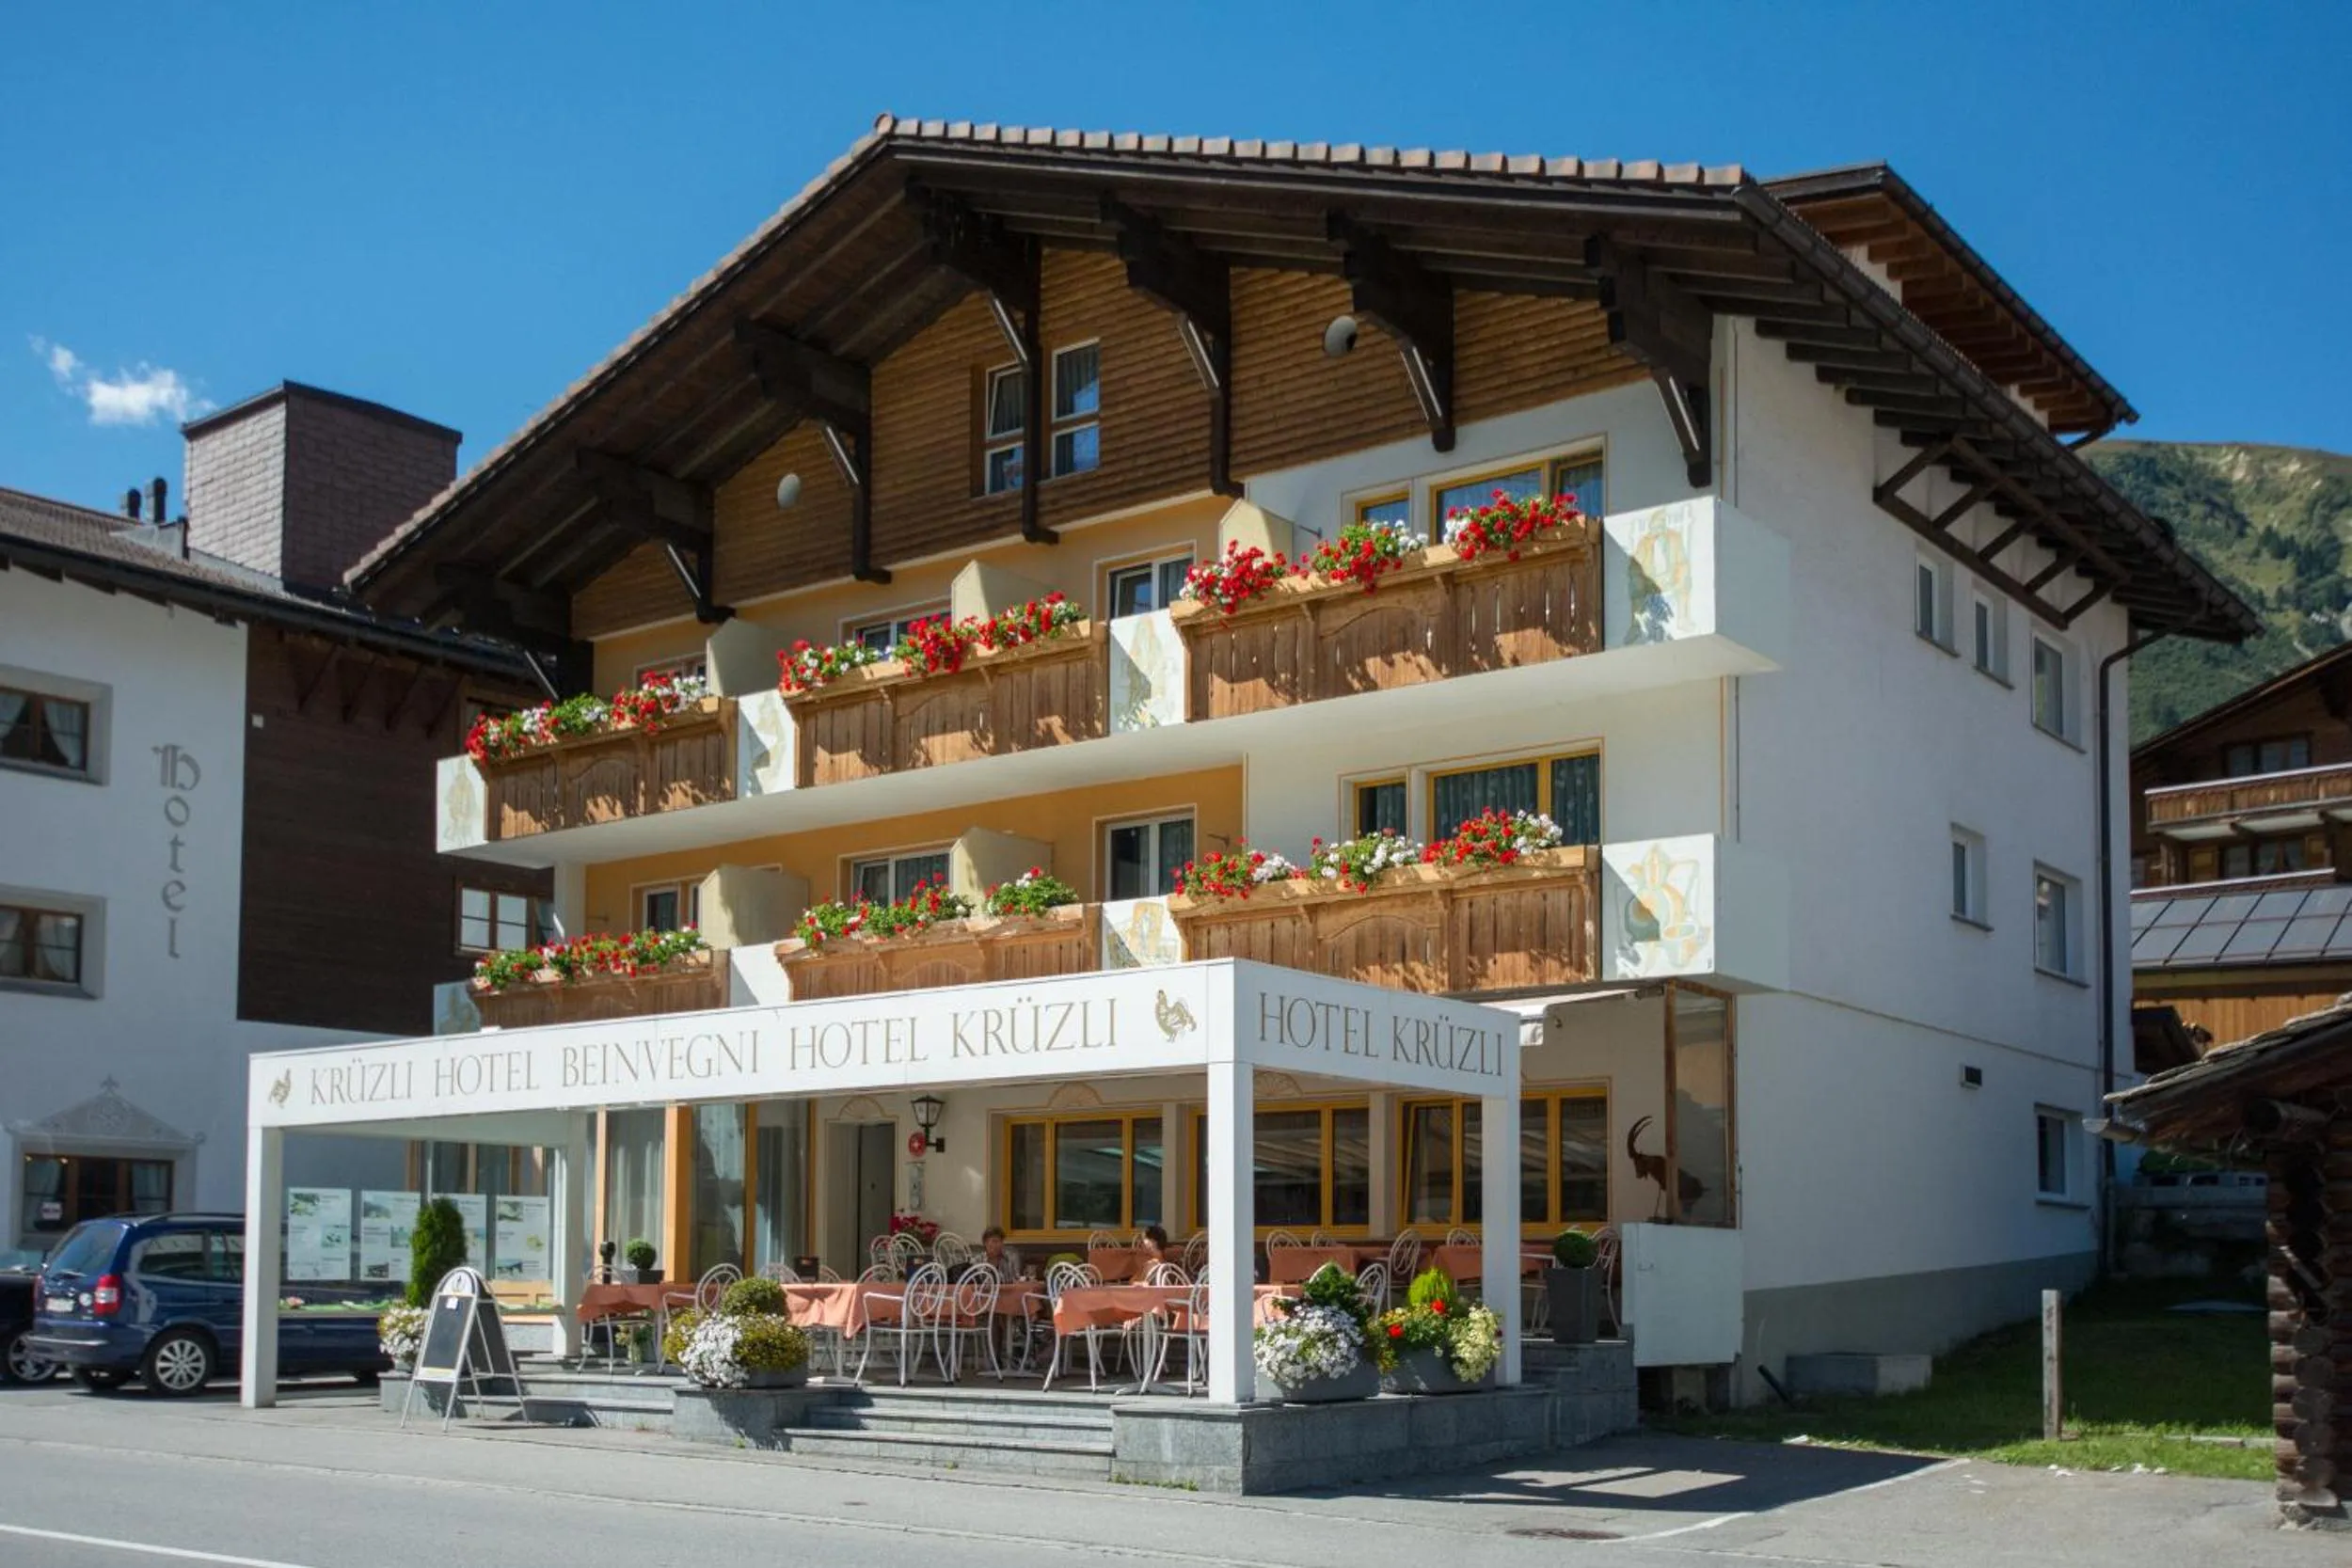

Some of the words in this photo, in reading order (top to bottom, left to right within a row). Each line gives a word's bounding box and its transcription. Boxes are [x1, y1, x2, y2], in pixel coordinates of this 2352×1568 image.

[310, 1056, 413, 1104] KRÜZLI
[434, 1051, 540, 1098] HOTEL
[563, 1030, 758, 1088] BEINVEGNI
[789, 1016, 929, 1070] HOTEL
[951, 997, 1117, 1058] KRÜZLI
[1259, 992, 1379, 1058] HOTEL
[1392, 1014, 1502, 1076] KRÜZLI
